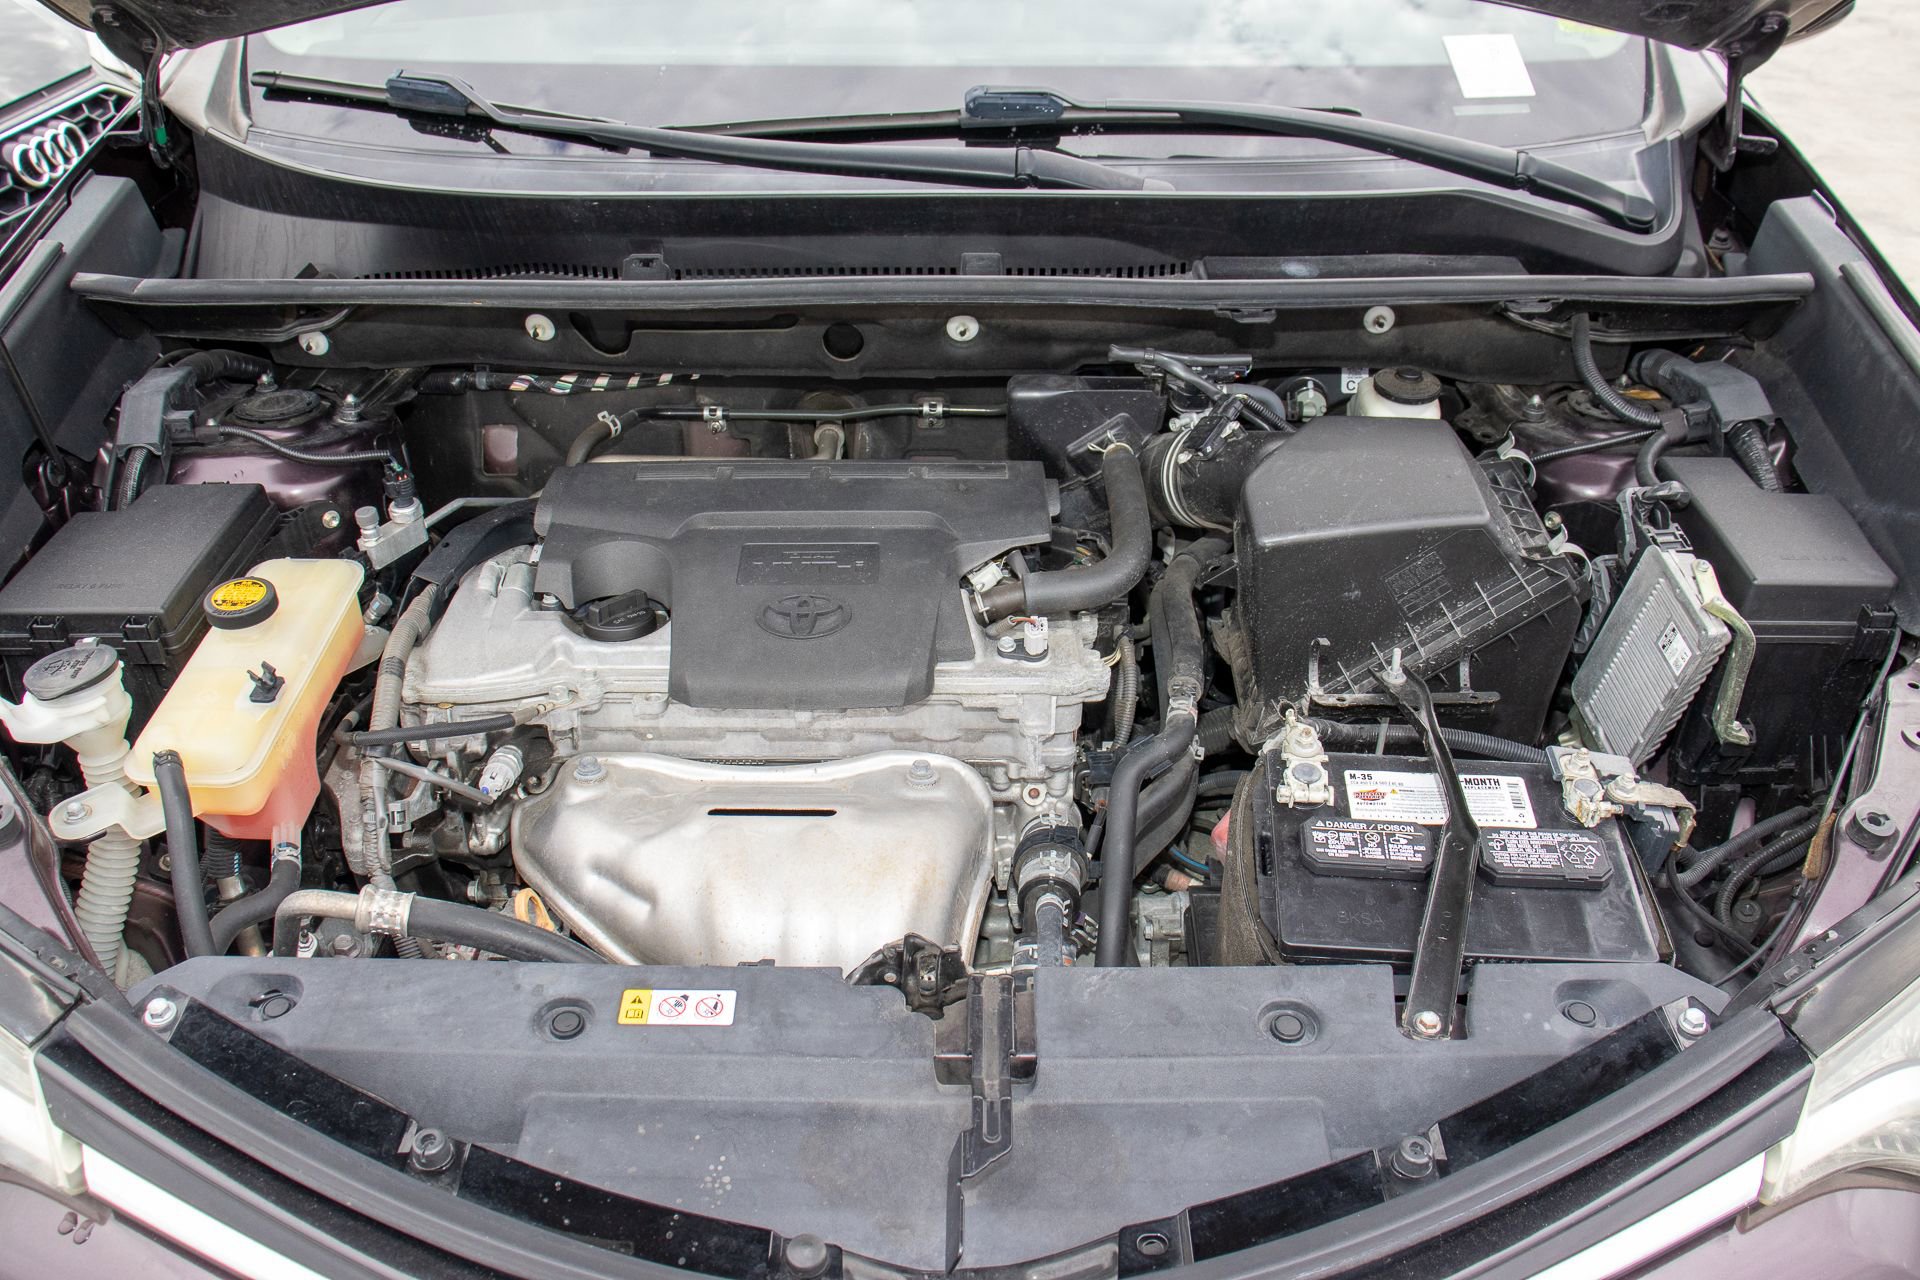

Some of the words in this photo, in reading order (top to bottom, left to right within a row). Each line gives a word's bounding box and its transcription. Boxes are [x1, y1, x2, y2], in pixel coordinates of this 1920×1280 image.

[1349, 773, 1373, 781] M-35
[1326, 821, 1367, 830] DANGER
[1377, 824, 1415, 832] POISON
